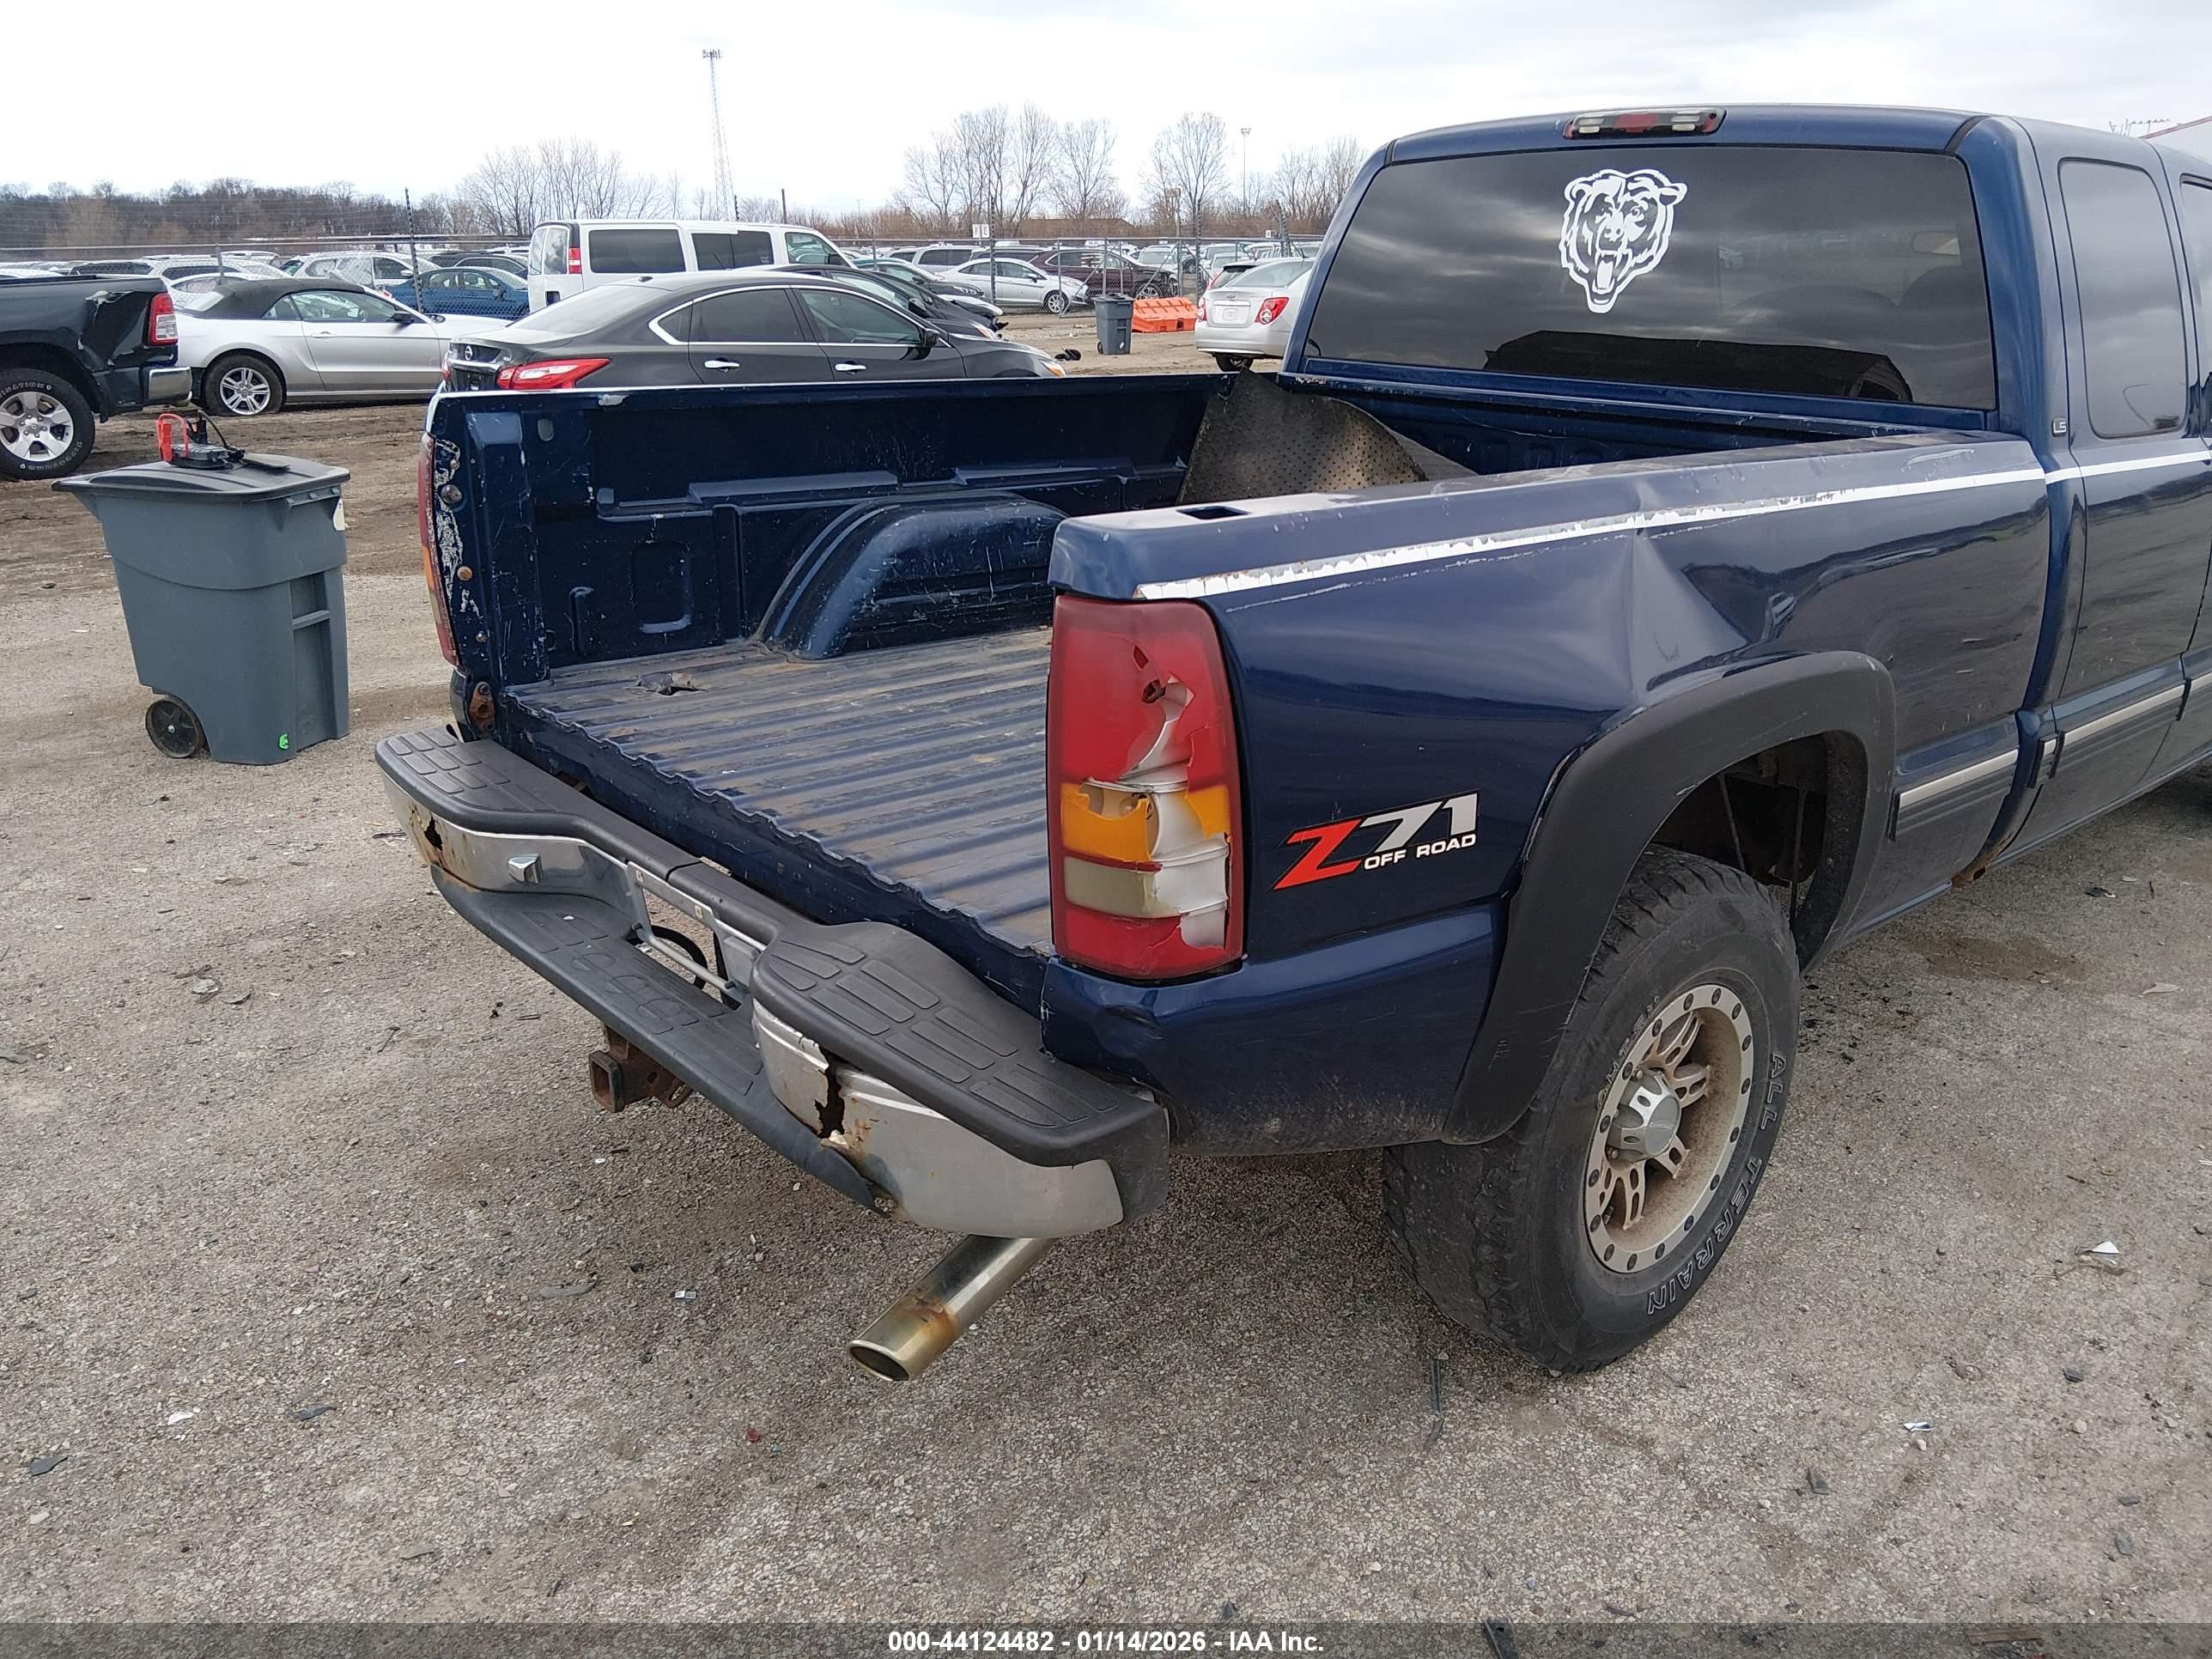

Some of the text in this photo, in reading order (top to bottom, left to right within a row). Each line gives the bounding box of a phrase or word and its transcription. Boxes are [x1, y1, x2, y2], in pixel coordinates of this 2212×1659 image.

[2052, 421, 2067, 434] LS
[1273, 793, 1478, 890] Z71
[1364, 833, 1477, 871] OFF ROAD
[1647, 1053, 1787, 1315] ALL TERRAIN
